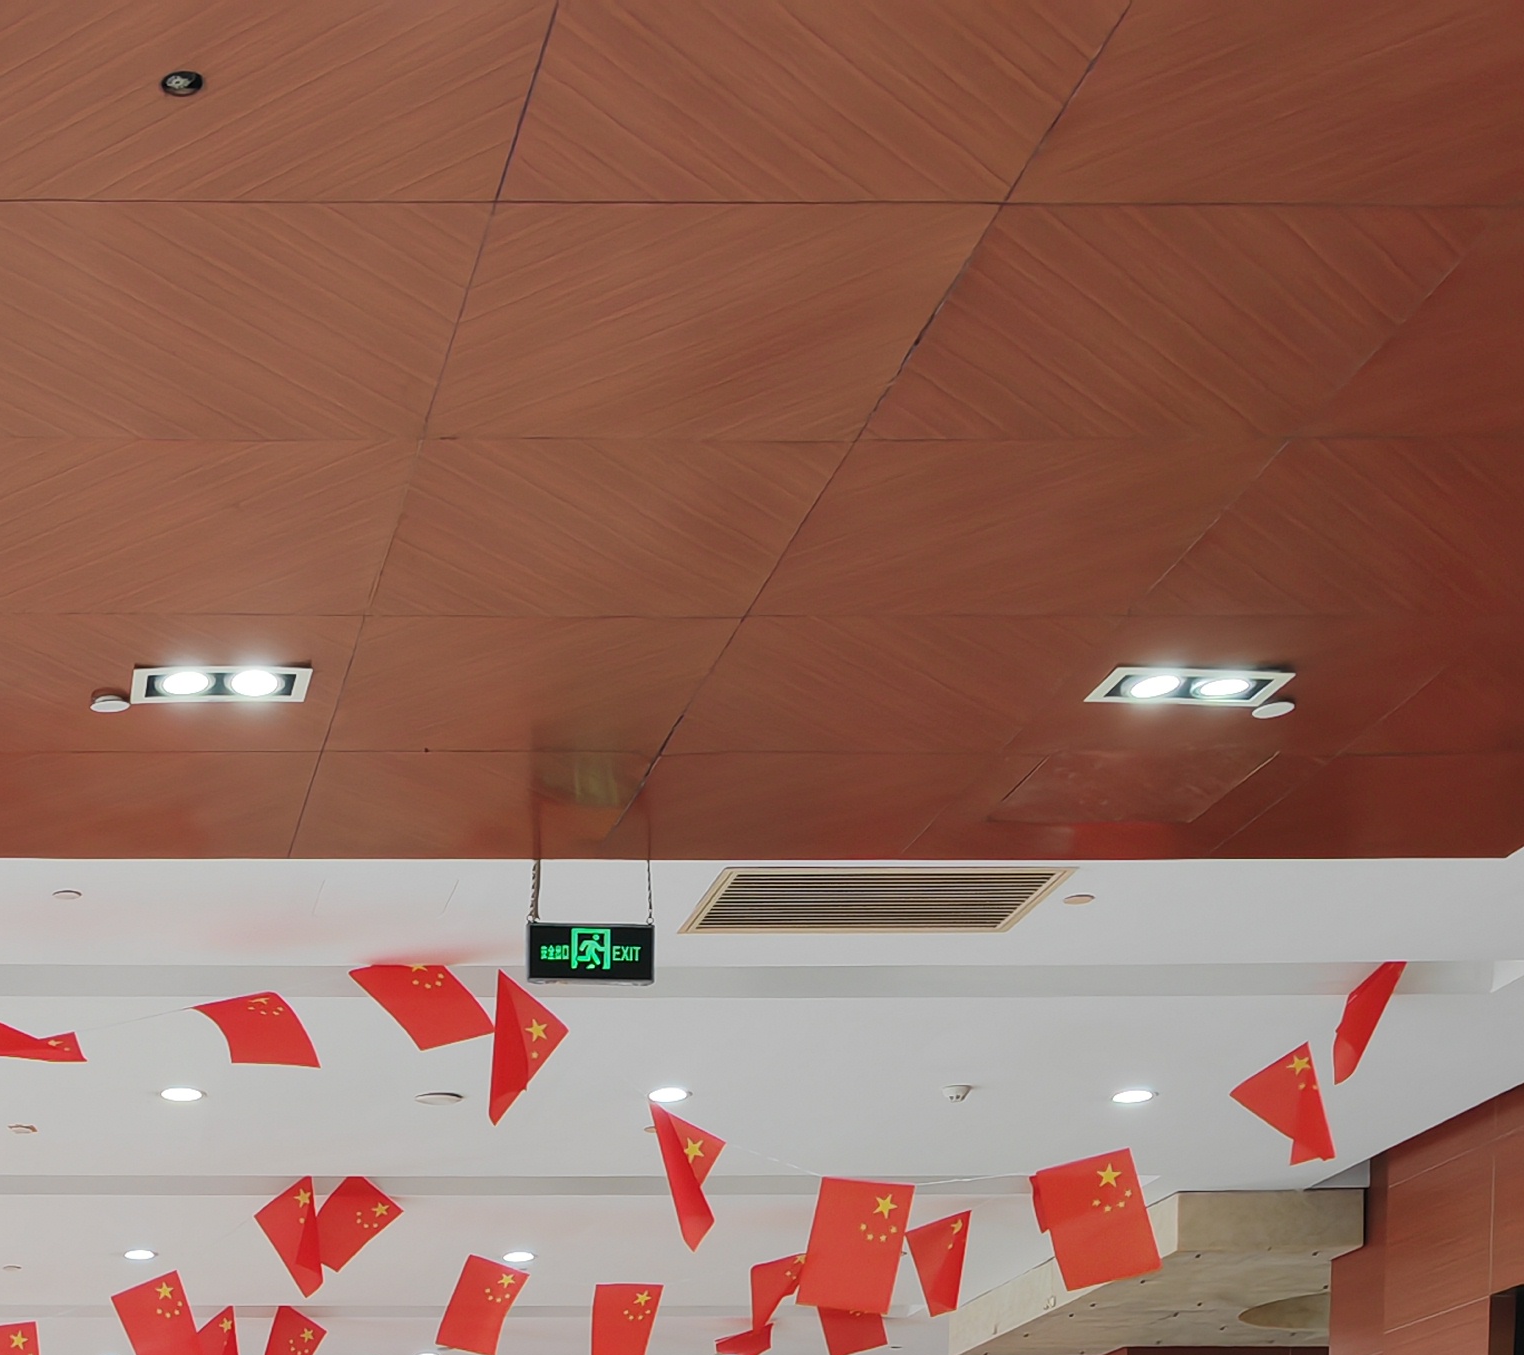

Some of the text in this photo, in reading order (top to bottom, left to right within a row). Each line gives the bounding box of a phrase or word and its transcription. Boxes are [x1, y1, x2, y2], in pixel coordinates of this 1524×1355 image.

[540, 944, 570, 960] 安全出口
[612, 945, 642, 962] EXIT
